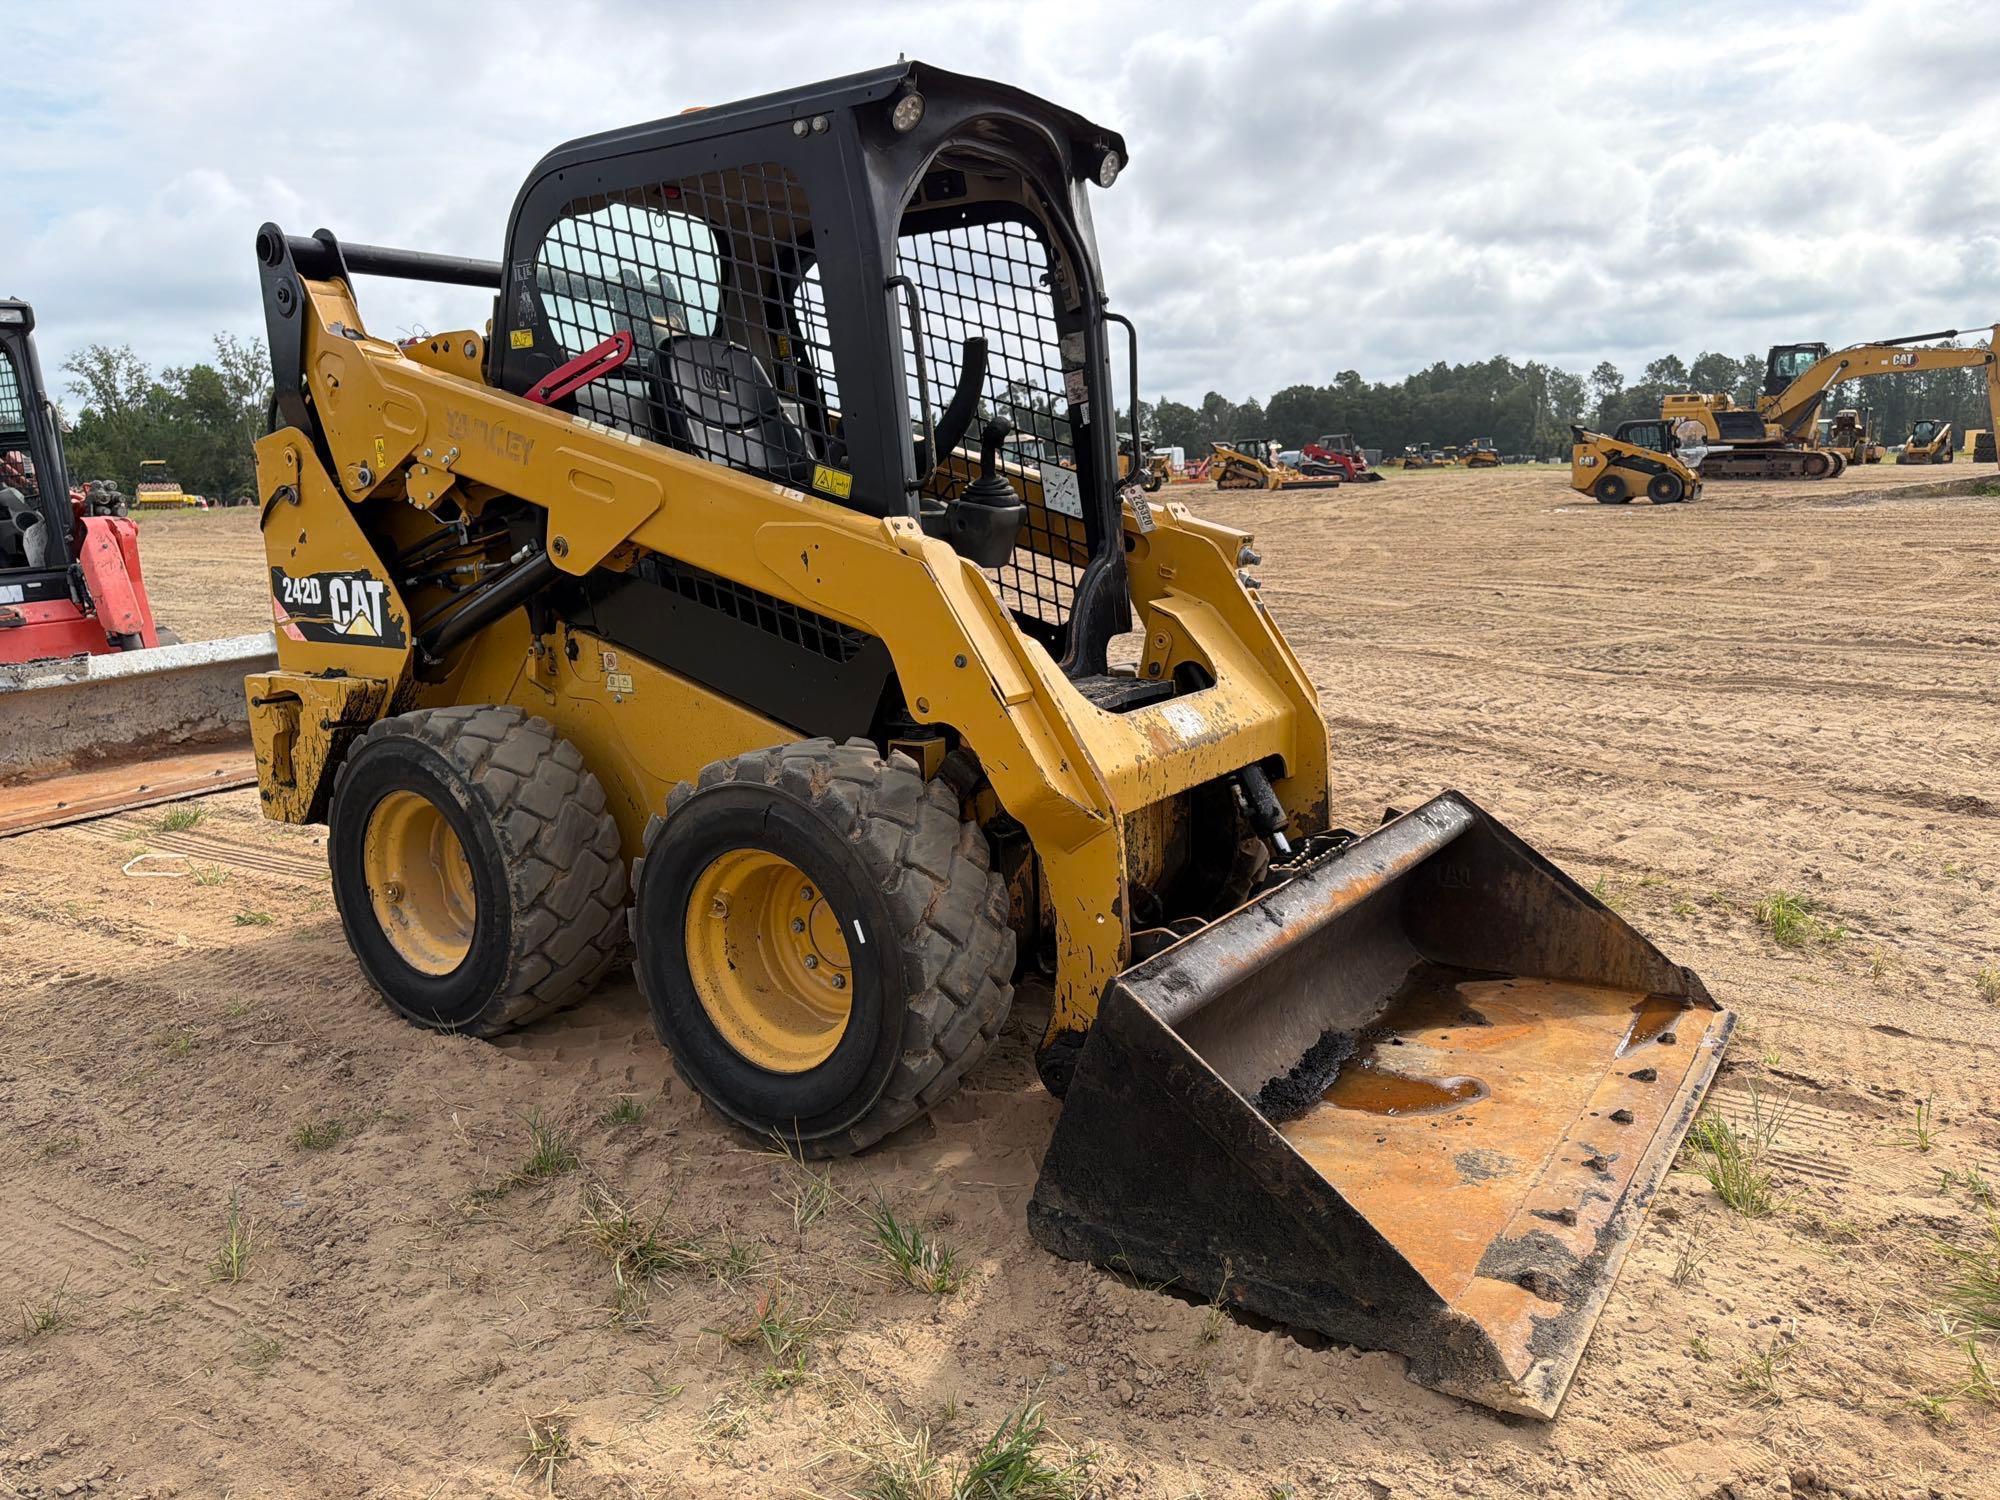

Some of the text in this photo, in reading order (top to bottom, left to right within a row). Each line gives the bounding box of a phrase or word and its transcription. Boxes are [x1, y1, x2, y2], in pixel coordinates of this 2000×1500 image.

[1892, 353, 1914, 365] CAT
[1579, 456, 1595, 466] CAT
[282, 577, 384, 637] 242D CAT
